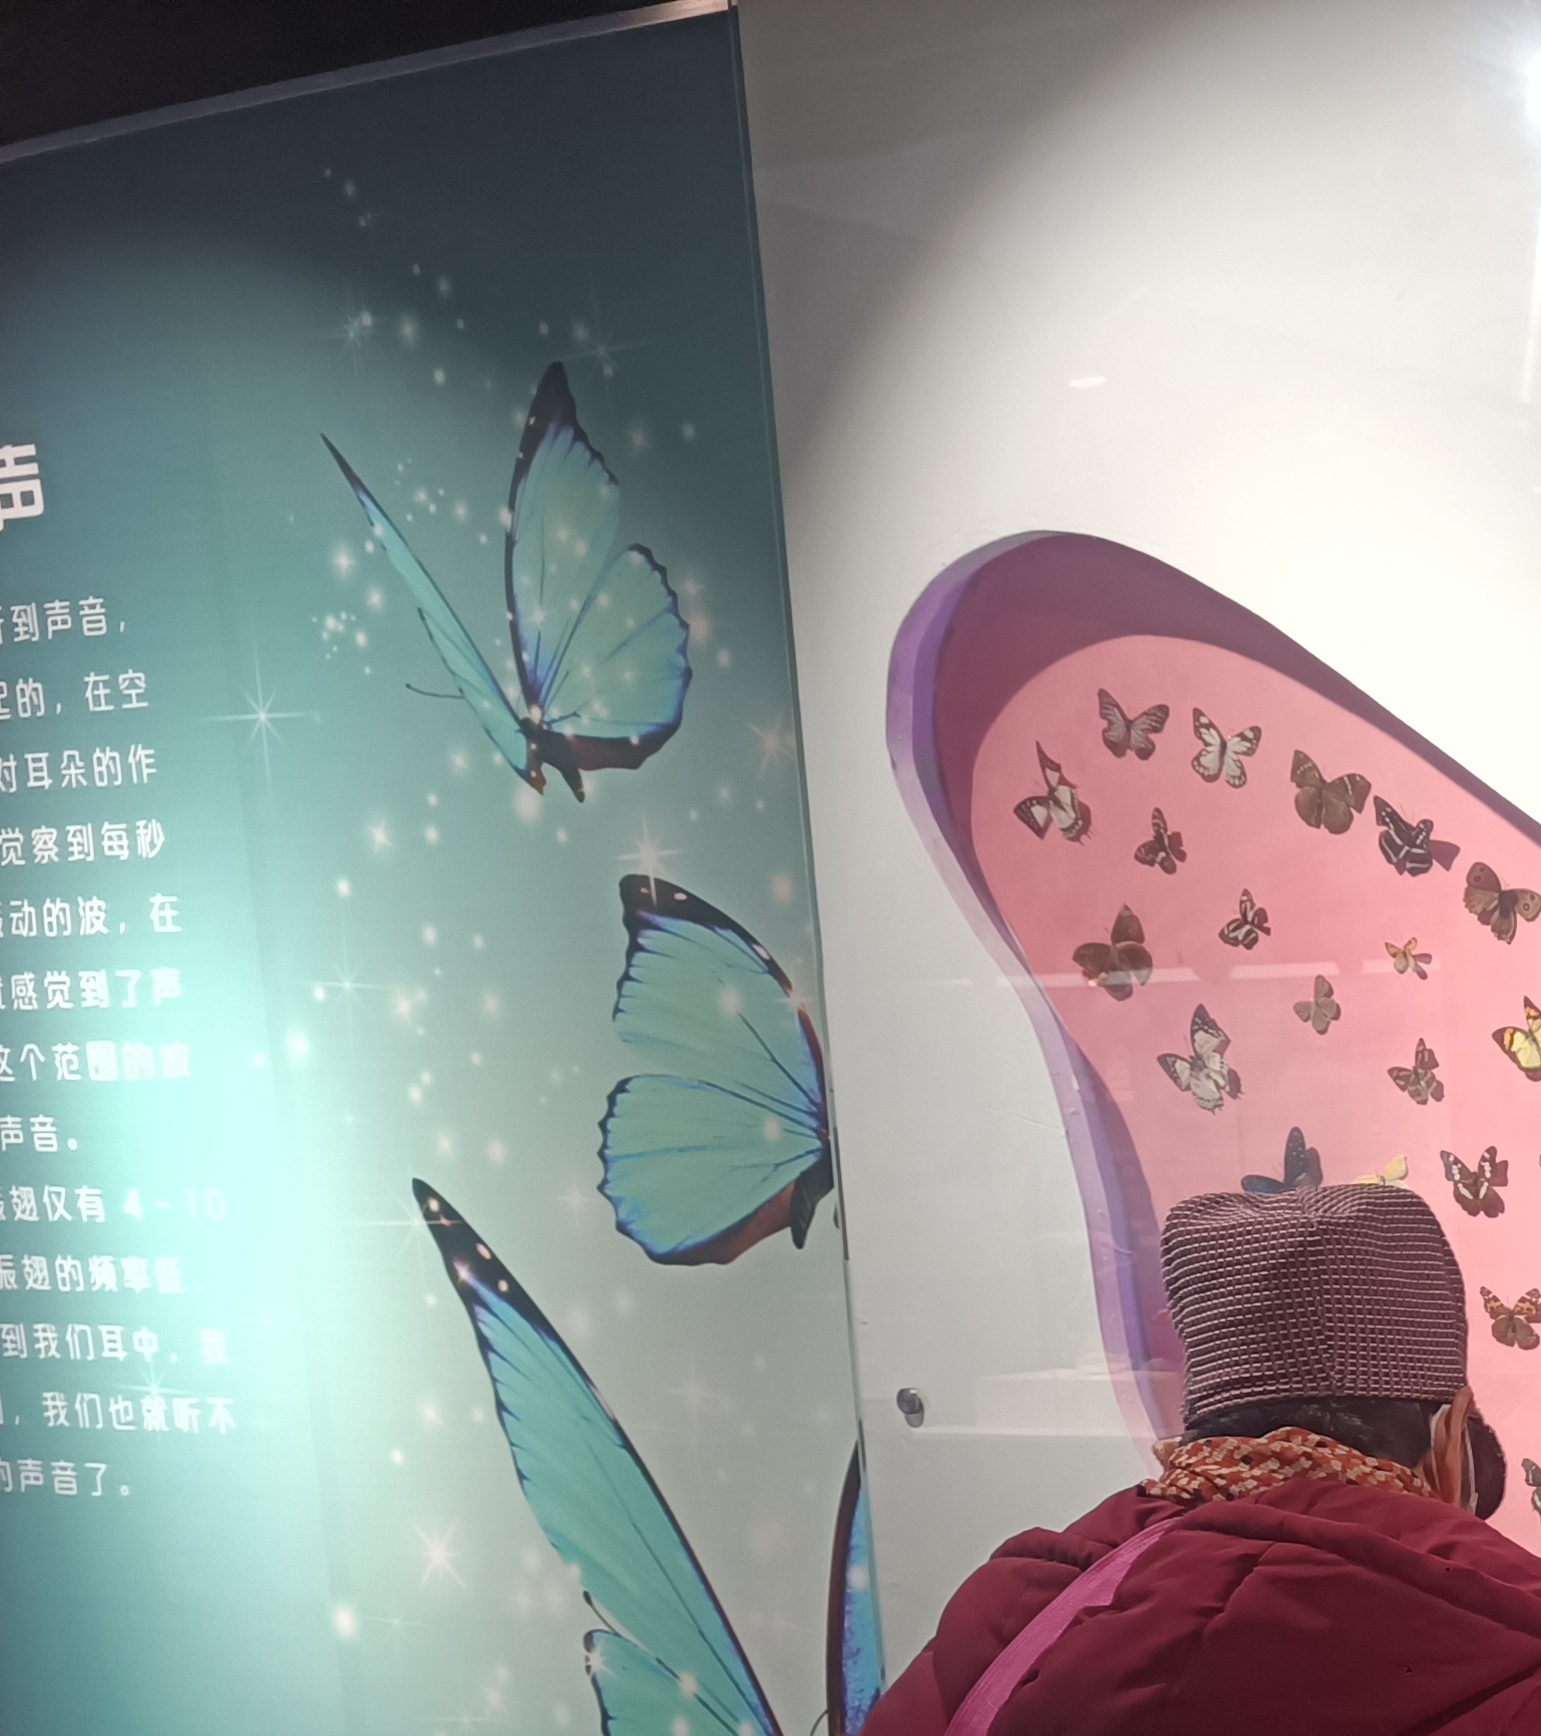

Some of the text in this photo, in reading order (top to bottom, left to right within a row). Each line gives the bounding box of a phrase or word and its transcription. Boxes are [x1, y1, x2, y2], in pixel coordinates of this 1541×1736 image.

[0, 443, 45, 531] 声
[0, 596, 127, 645] 到声音，
[0, 744, 157, 793] 对耳朵的作
[0, 818, 166, 866] 觉察到每秒
[0, 893, 182, 939] 动的波，在
[0, 967, 183, 1011] 感觉到了声
[0, 1114, 78, 1153] 声音。
[0, 1391, 236, 1435] ，我们也就听不
